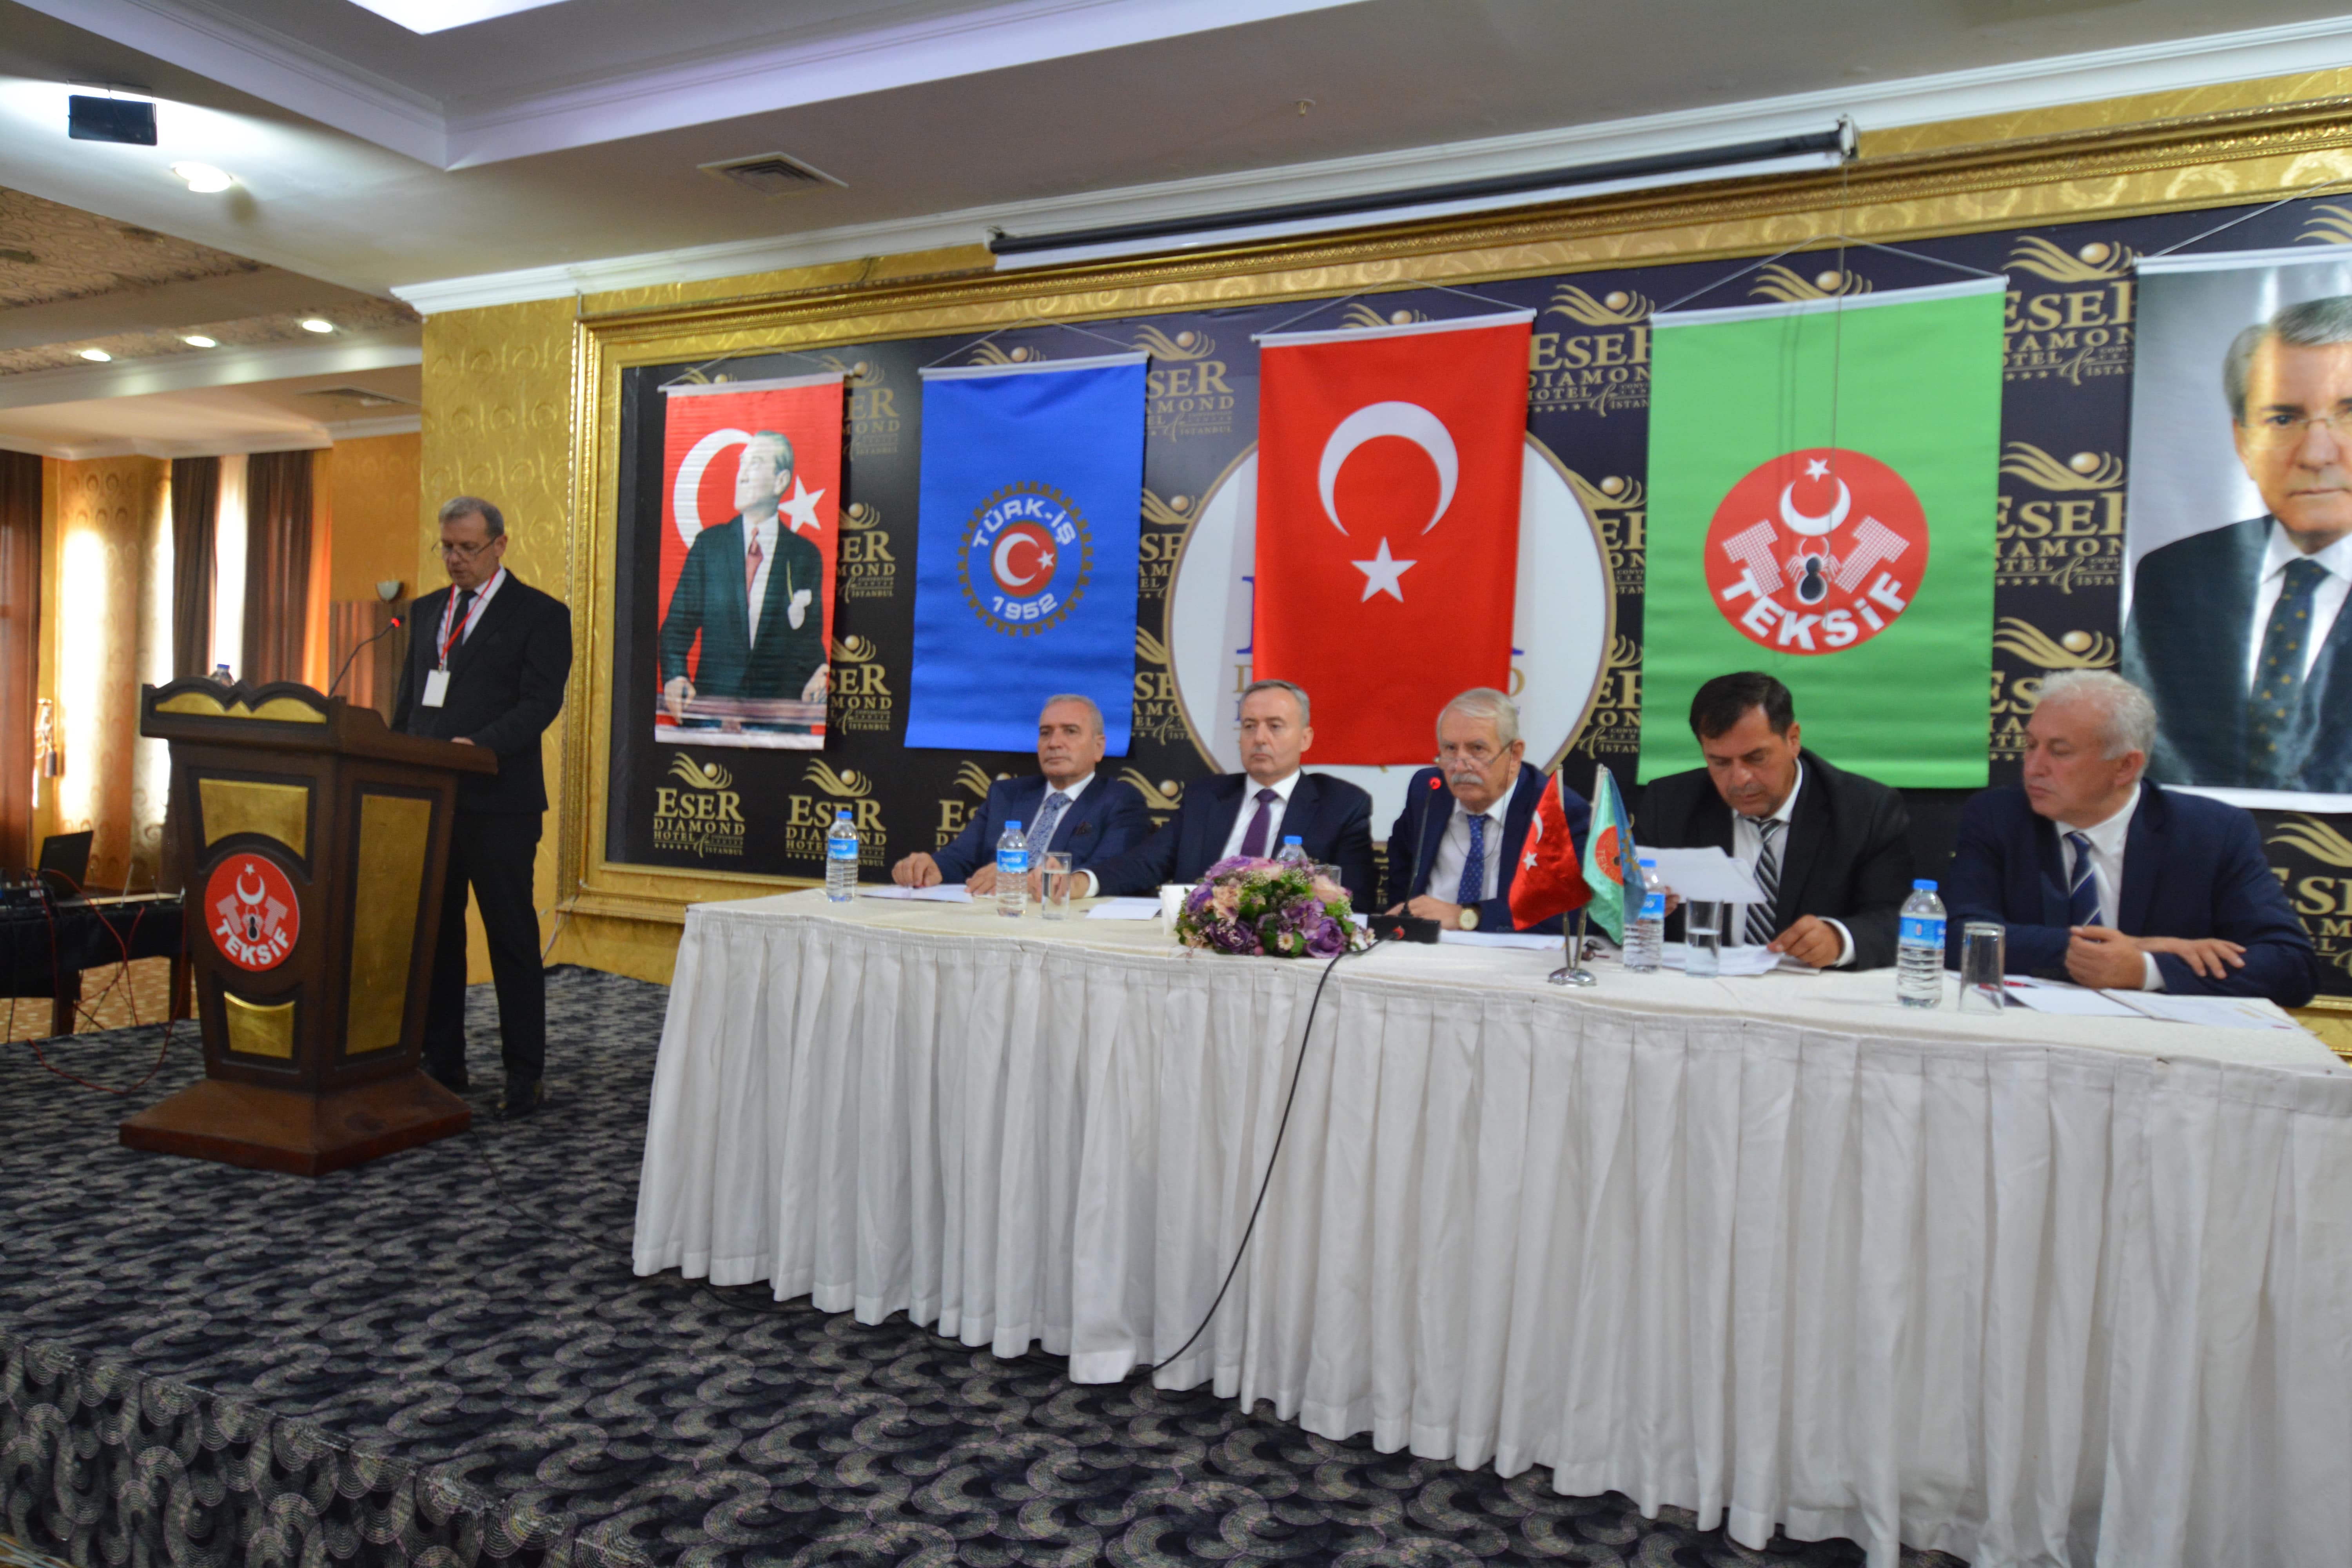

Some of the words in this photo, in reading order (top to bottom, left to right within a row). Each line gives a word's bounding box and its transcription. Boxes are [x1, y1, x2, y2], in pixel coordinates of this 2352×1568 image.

[1146, 361, 1234, 399] SER
[846, 388, 900, 420] ER
[1147, 396, 1234, 414] MOND
[840, 531, 896, 563] ER
[837, 563, 896, 577] MOND
[993, 593, 1057, 620] 1952
[831, 696, 892, 709] MOND
[654, 788, 745, 822] ESER
[654, 818, 745, 835] DIAMOND
[654, 830, 695, 842] HOTEL
[786, 826, 887, 845] DIAND
